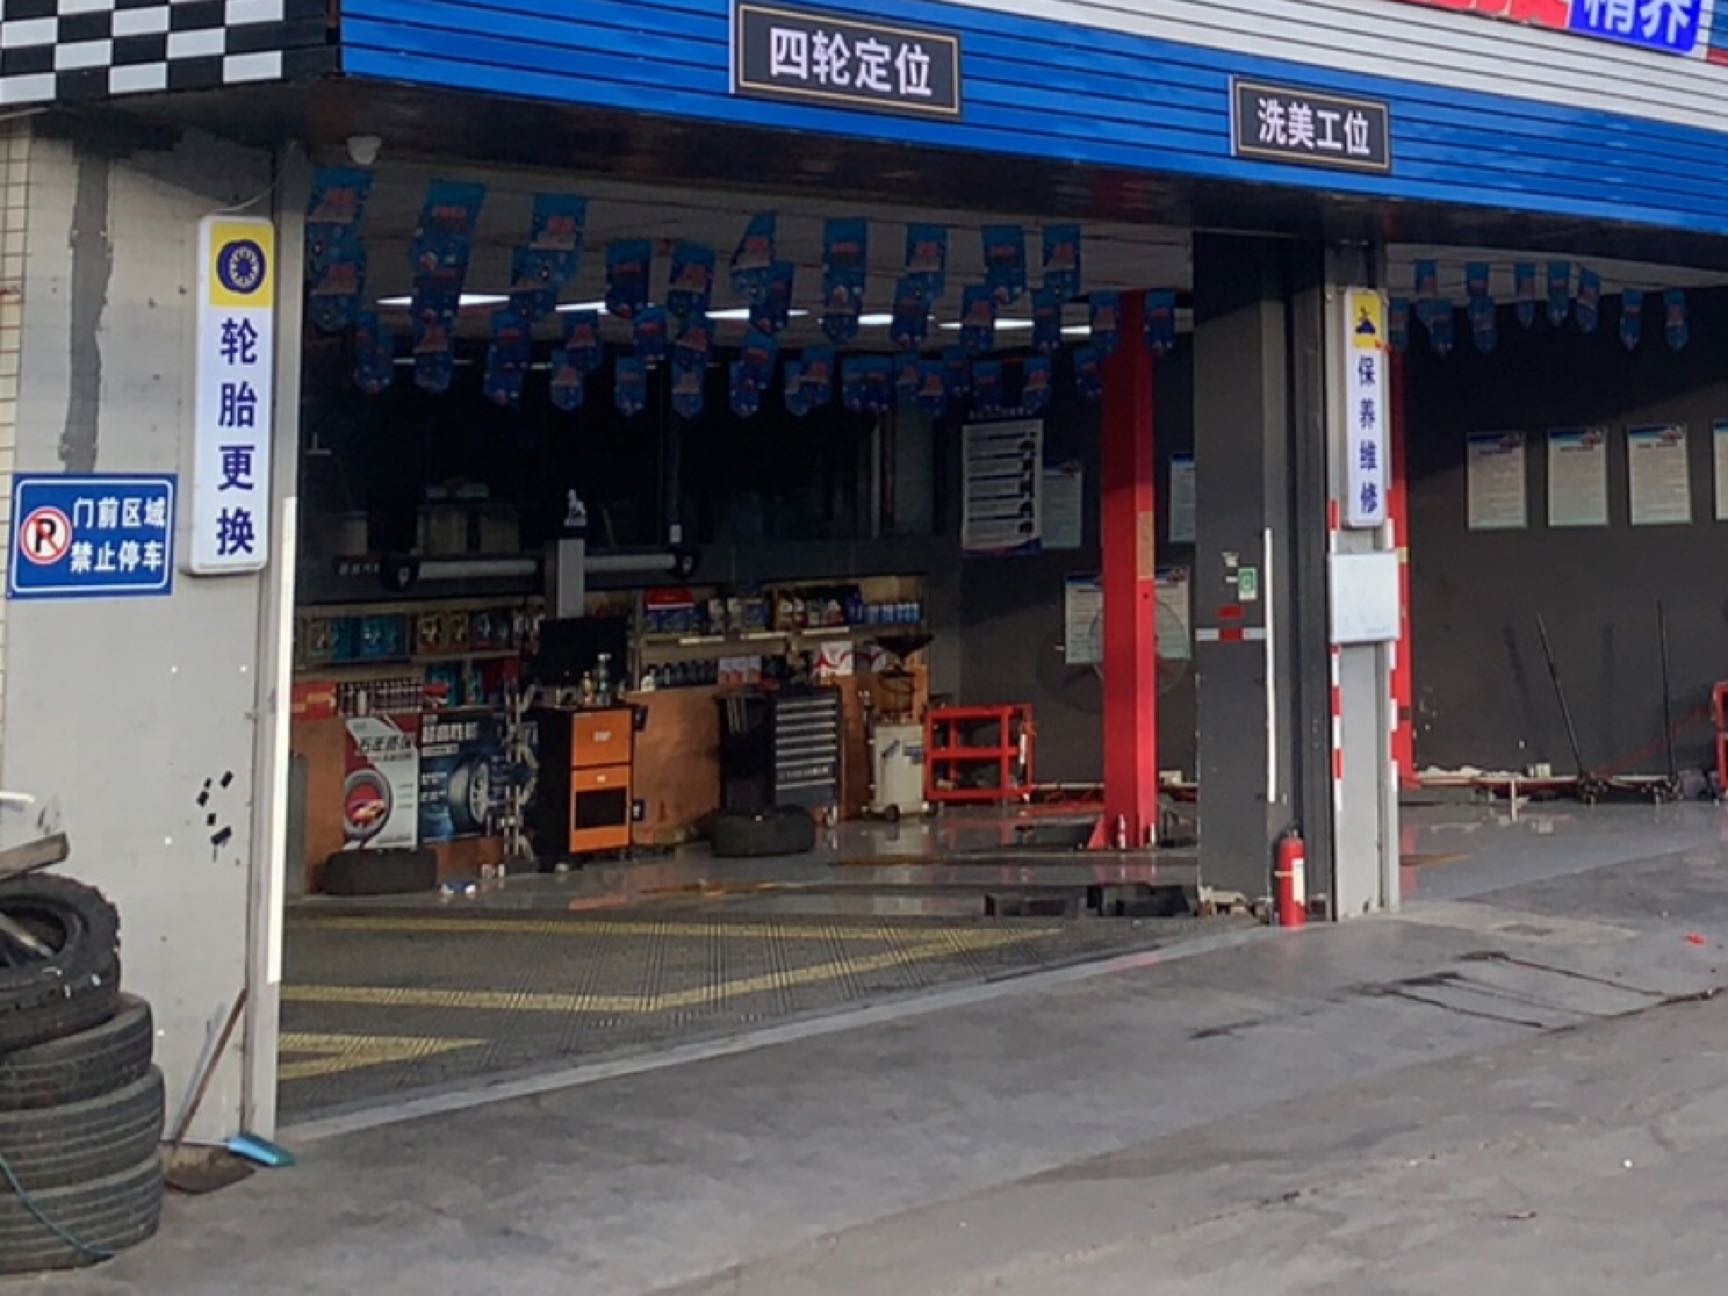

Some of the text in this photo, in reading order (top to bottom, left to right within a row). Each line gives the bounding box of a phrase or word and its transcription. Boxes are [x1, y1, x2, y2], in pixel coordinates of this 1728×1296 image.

[769, 27, 933, 98] 四轮定位
[1258, 99, 1371, 155] 洗美工位
[216, 317, 258, 556] 轮胎更换
[1356, 355, 1379, 514] 保养维修
[72, 497, 166, 529] 门前区域
[70, 541, 164, 575] 禁止停车
